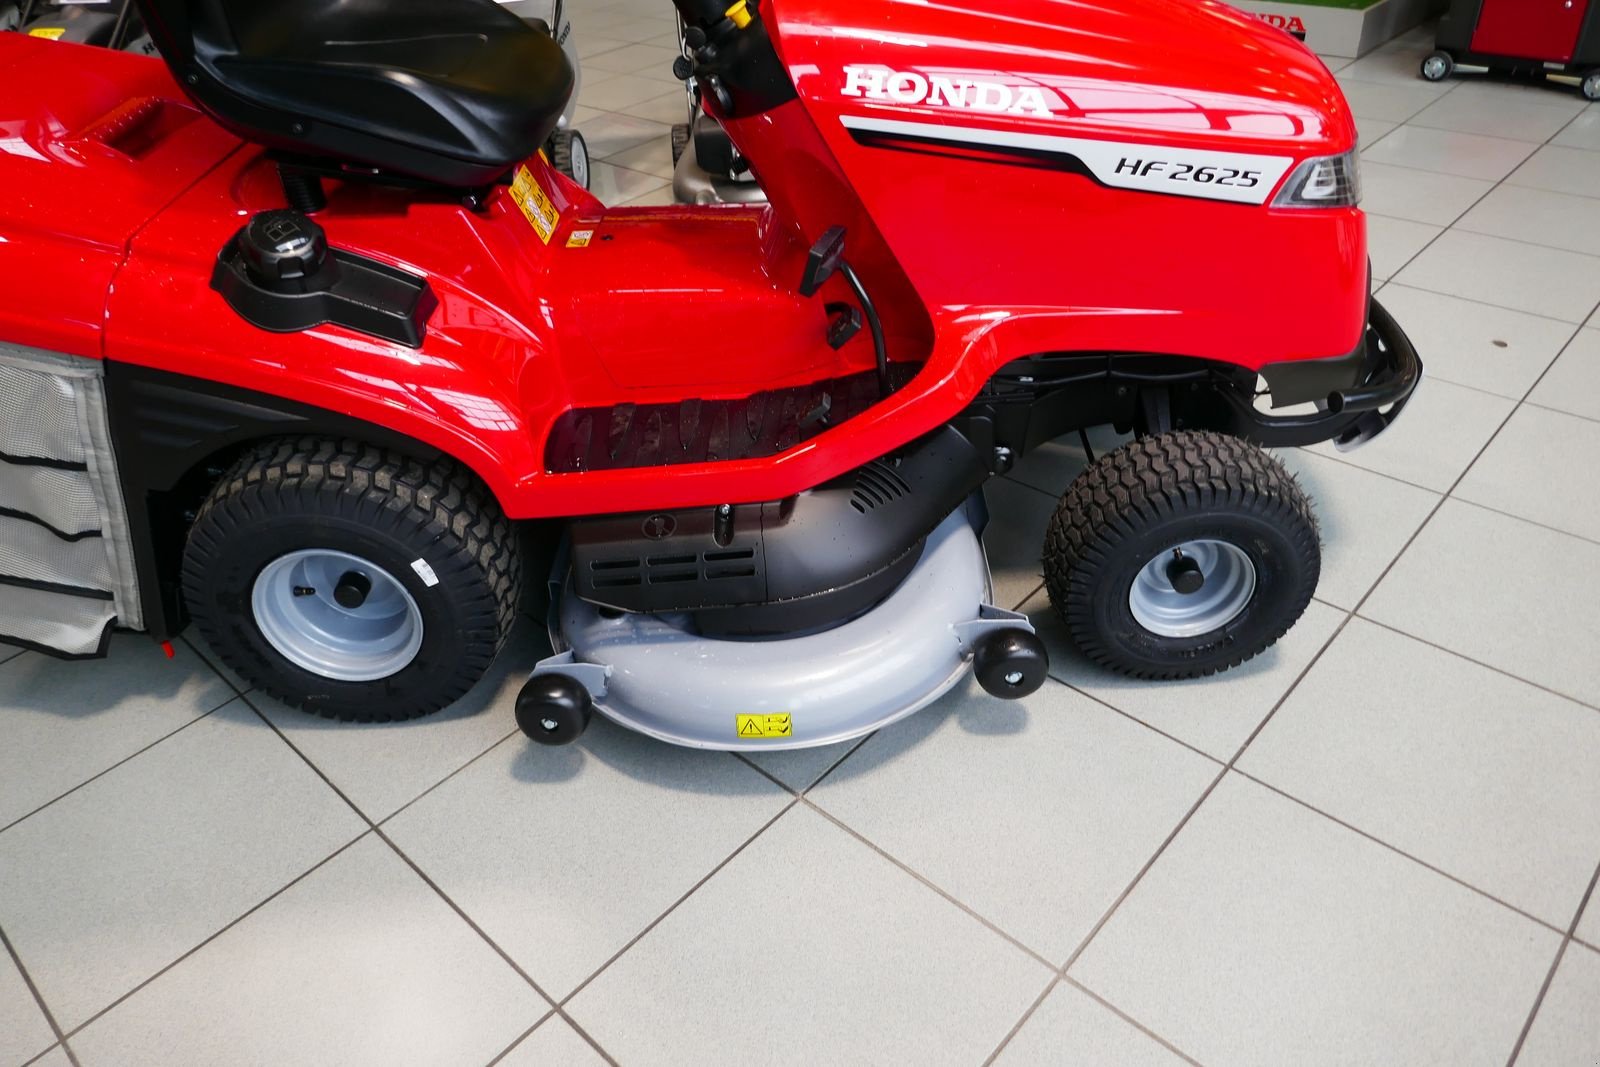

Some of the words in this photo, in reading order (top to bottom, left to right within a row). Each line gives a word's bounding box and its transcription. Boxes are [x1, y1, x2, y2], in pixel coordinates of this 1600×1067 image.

[840, 65, 1053, 118] HONDA
[1114, 157, 1168, 177] HF
[1168, 163, 1262, 188] 2625
